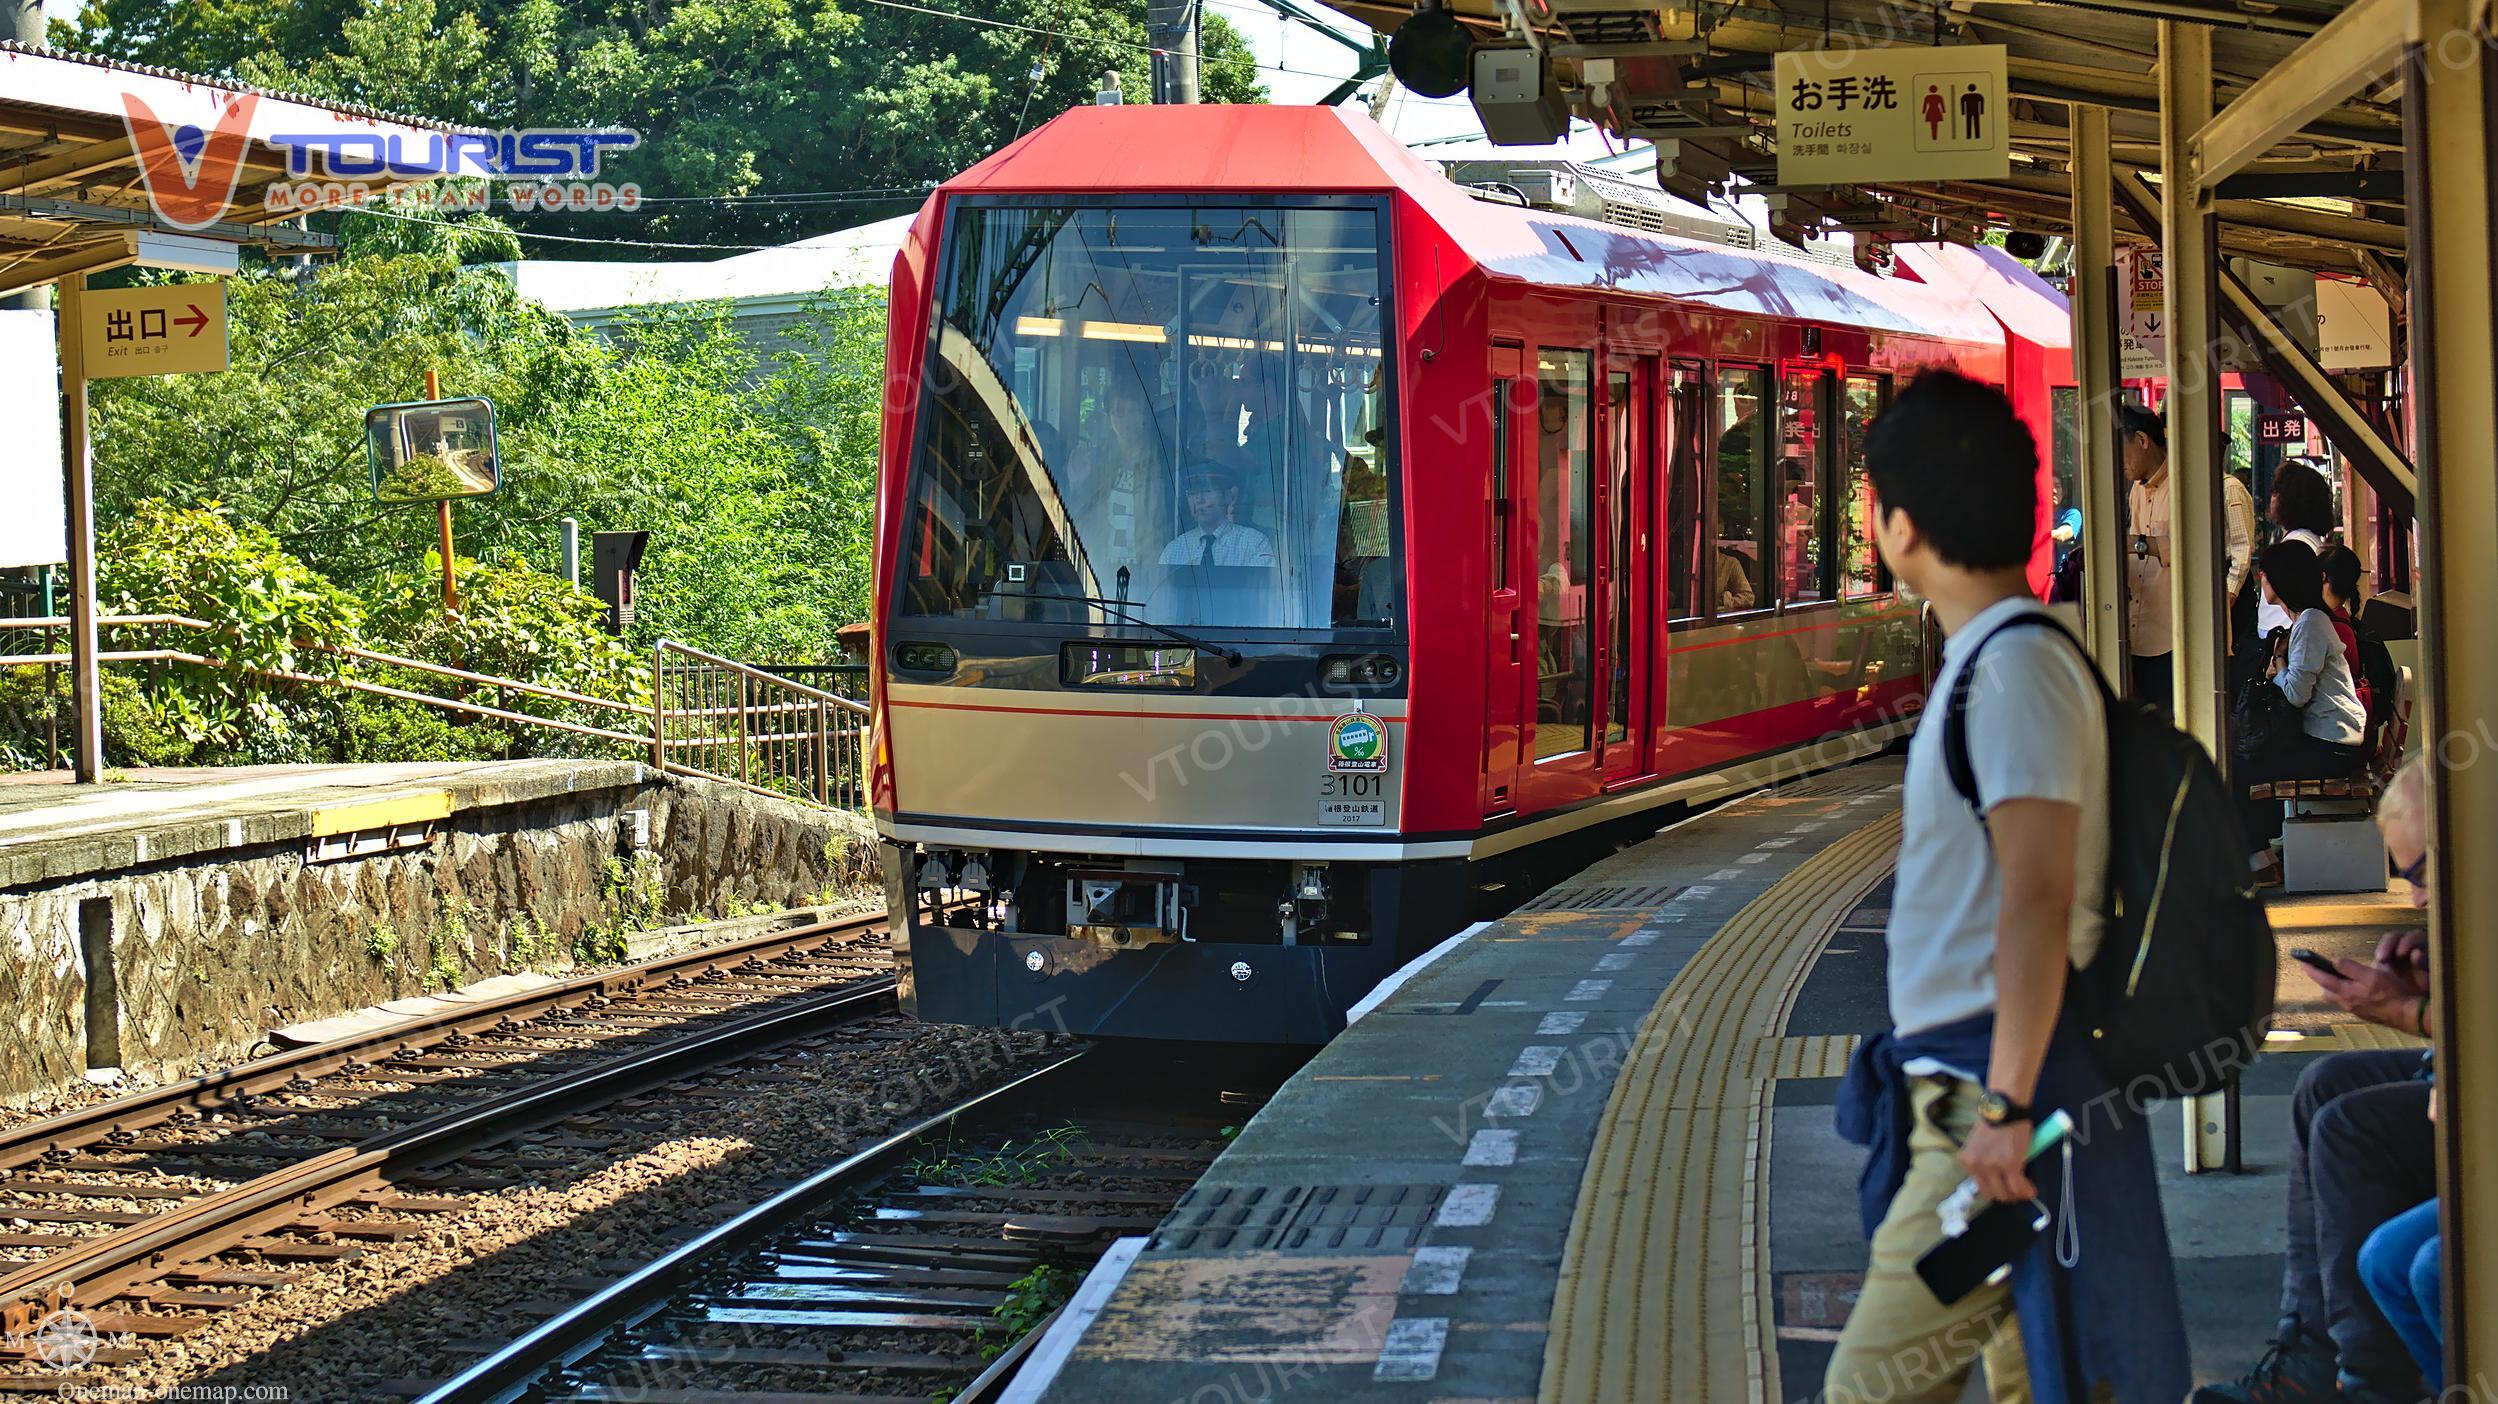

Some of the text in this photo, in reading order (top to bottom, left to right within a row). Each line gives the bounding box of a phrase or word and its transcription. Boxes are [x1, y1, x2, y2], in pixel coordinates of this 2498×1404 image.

[1791, 75, 1898, 112] お手洗
[1792, 121, 1852, 139] Toilets
[1836, 142, 1872, 155] 화장실
[107, 309, 167, 342] 出口
[107, 346, 128, 357] Exit
[135, 346, 150, 355] 出口
[2263, 420, 2301, 438] 出発
[1320, 775, 1381, 796] 3101
